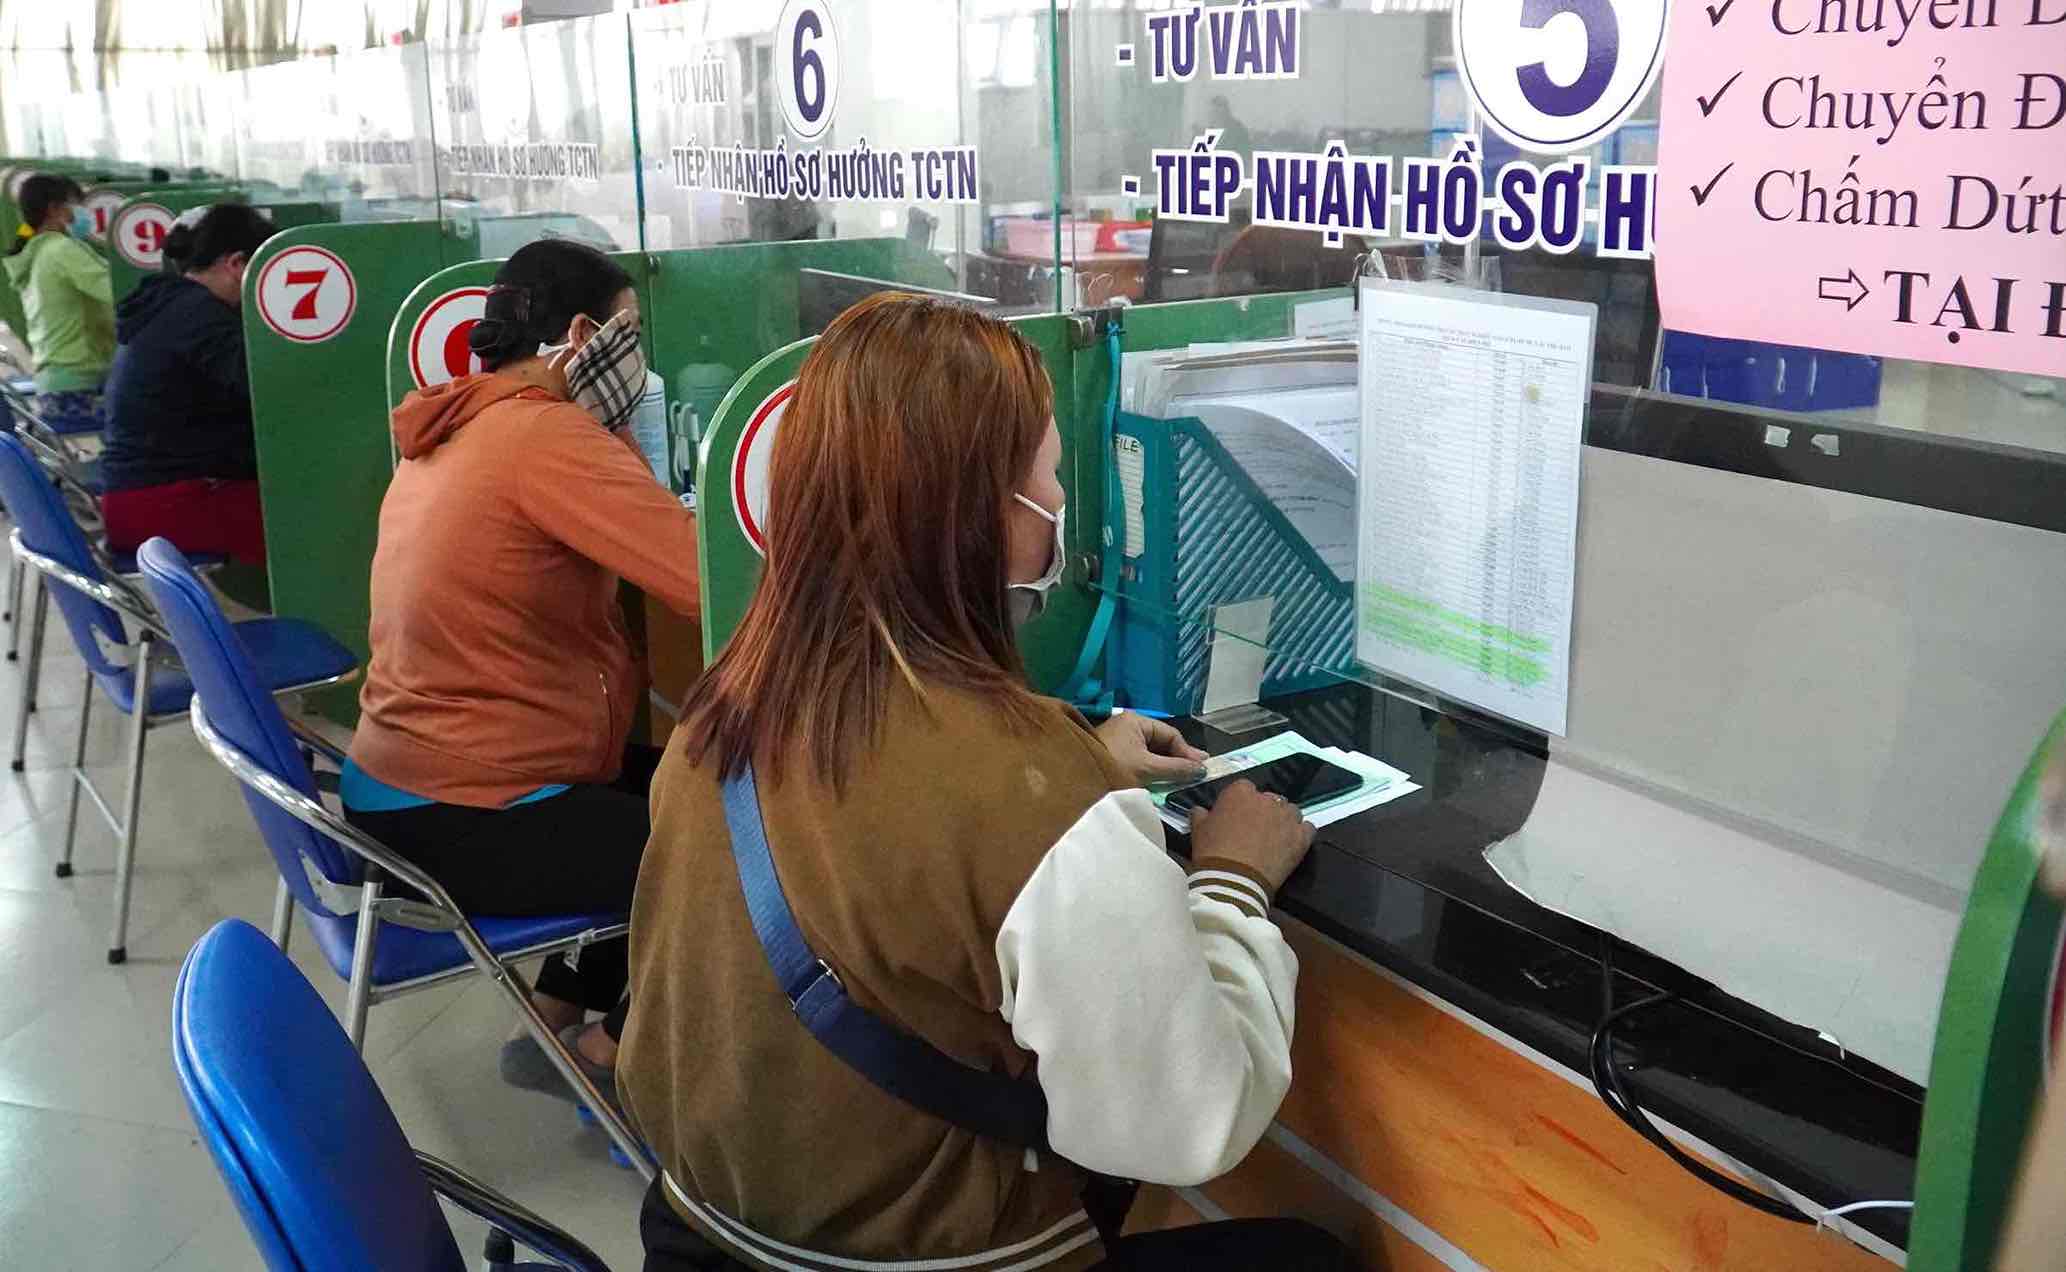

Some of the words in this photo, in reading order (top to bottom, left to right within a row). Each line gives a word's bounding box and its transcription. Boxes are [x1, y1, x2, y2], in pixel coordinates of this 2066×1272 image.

[793, 10, 825, 122] 6
[1149, 8, 1200, 77] TƯ
[1209, 0, 1296, 75] VẤN
[1762, 57, 1990, 145] Chuyển
[672, 136, 705, 187] TIẾP
[711, 143, 758, 201] NHẬN
[764, 138, 789, 195] HỒ
[795, 150, 820, 198] SƠ
[828, 137, 904, 199] HƯỞNG
[911, 150, 977, 200] TCTN
[1156, 135, 1241, 216] TIẾP
[1256, 146, 1388, 242] NHẬN
[1406, 141, 1478, 238] HỒ
[1500, 163, 1585, 246] SƠ
[1604, 173, 1657, 250] H
[1754, 155, 1920, 228] Chấm
[1941, 175, 2066, 235] Dứt
[134, 220, 166, 252] 9
[285, 269, 329, 320] 7
[1883, 270, 2021, 343] TẠI
